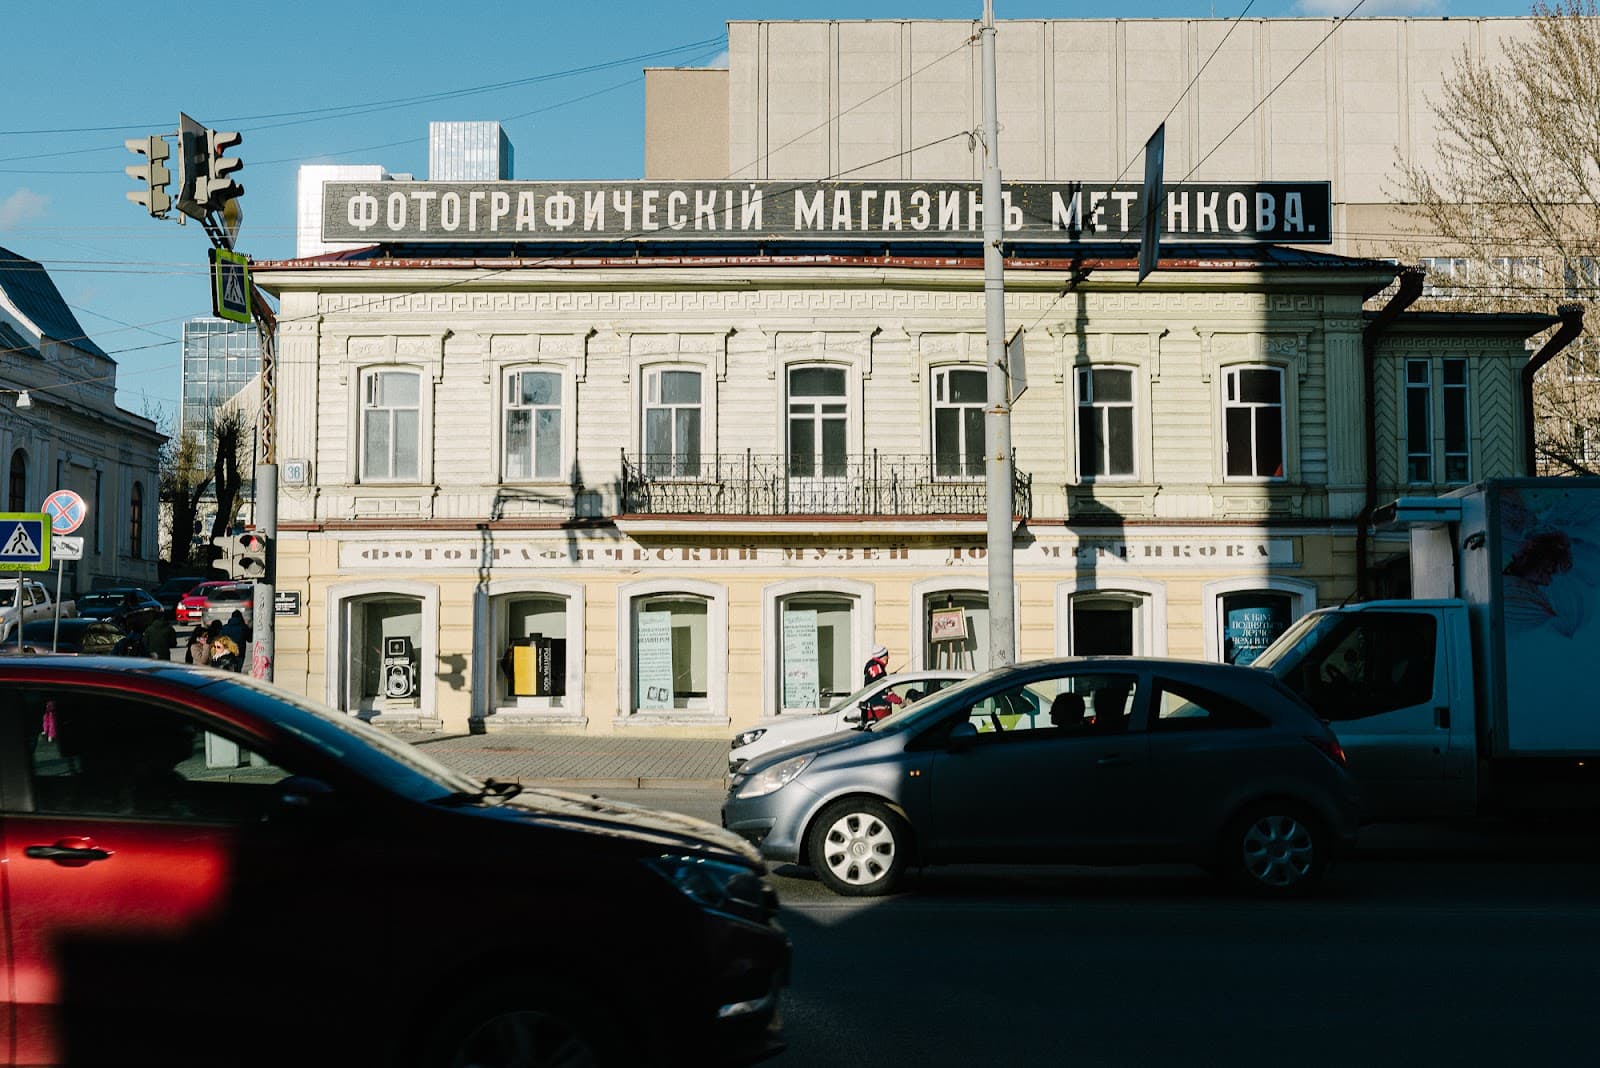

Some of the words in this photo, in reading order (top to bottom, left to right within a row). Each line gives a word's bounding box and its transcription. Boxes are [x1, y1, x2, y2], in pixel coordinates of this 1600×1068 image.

[347, 184, 764, 232] ФОТОГРАФИЧЕСКІЙ
[794, 189, 1023, 232] МАГАЗИНЪ
[1051, 190, 1316, 233] МЕТНКОВА.
[361, 544, 758, 561] ФОТОГРАФИЧЕСКИЙ
[783, 543, 910, 561] МУЗЕЙ
[945, 545, 987, 566] ДО
[1040, 545, 1269, 559] МЕТЕНКОВА
